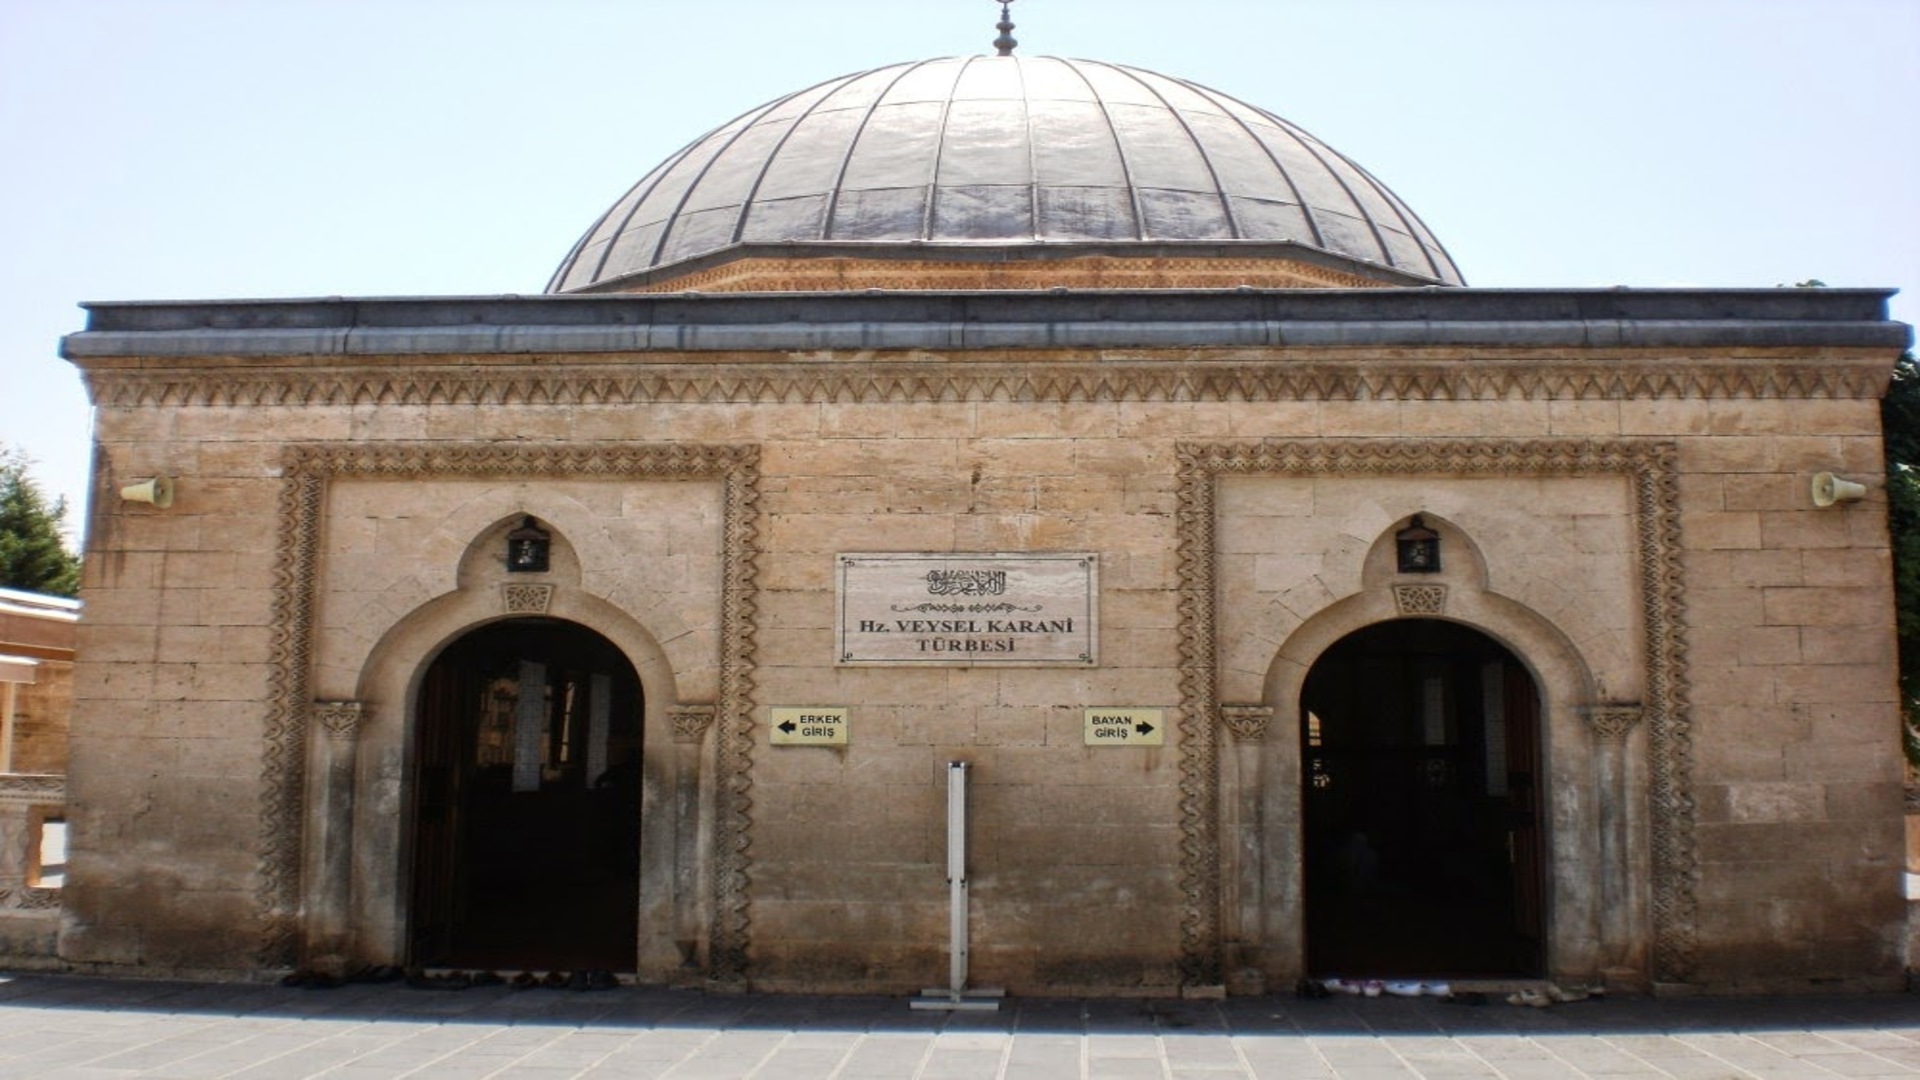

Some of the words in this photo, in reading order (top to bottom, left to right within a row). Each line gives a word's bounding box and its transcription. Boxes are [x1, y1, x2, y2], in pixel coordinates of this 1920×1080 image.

[860, 620, 890, 633] Hz.
[895, 620, 982, 633] VEYSEL
[987, 617, 1074, 633] KARANİ
[915, 636, 1015, 652] TÜRBESİ
[800, 715, 842, 724] ERKEK
[1092, 715, 1132, 725] BAYAN
[802, 726, 835, 738] GİRİŞ
[1094, 727, 1129, 740] GİRİŞ
